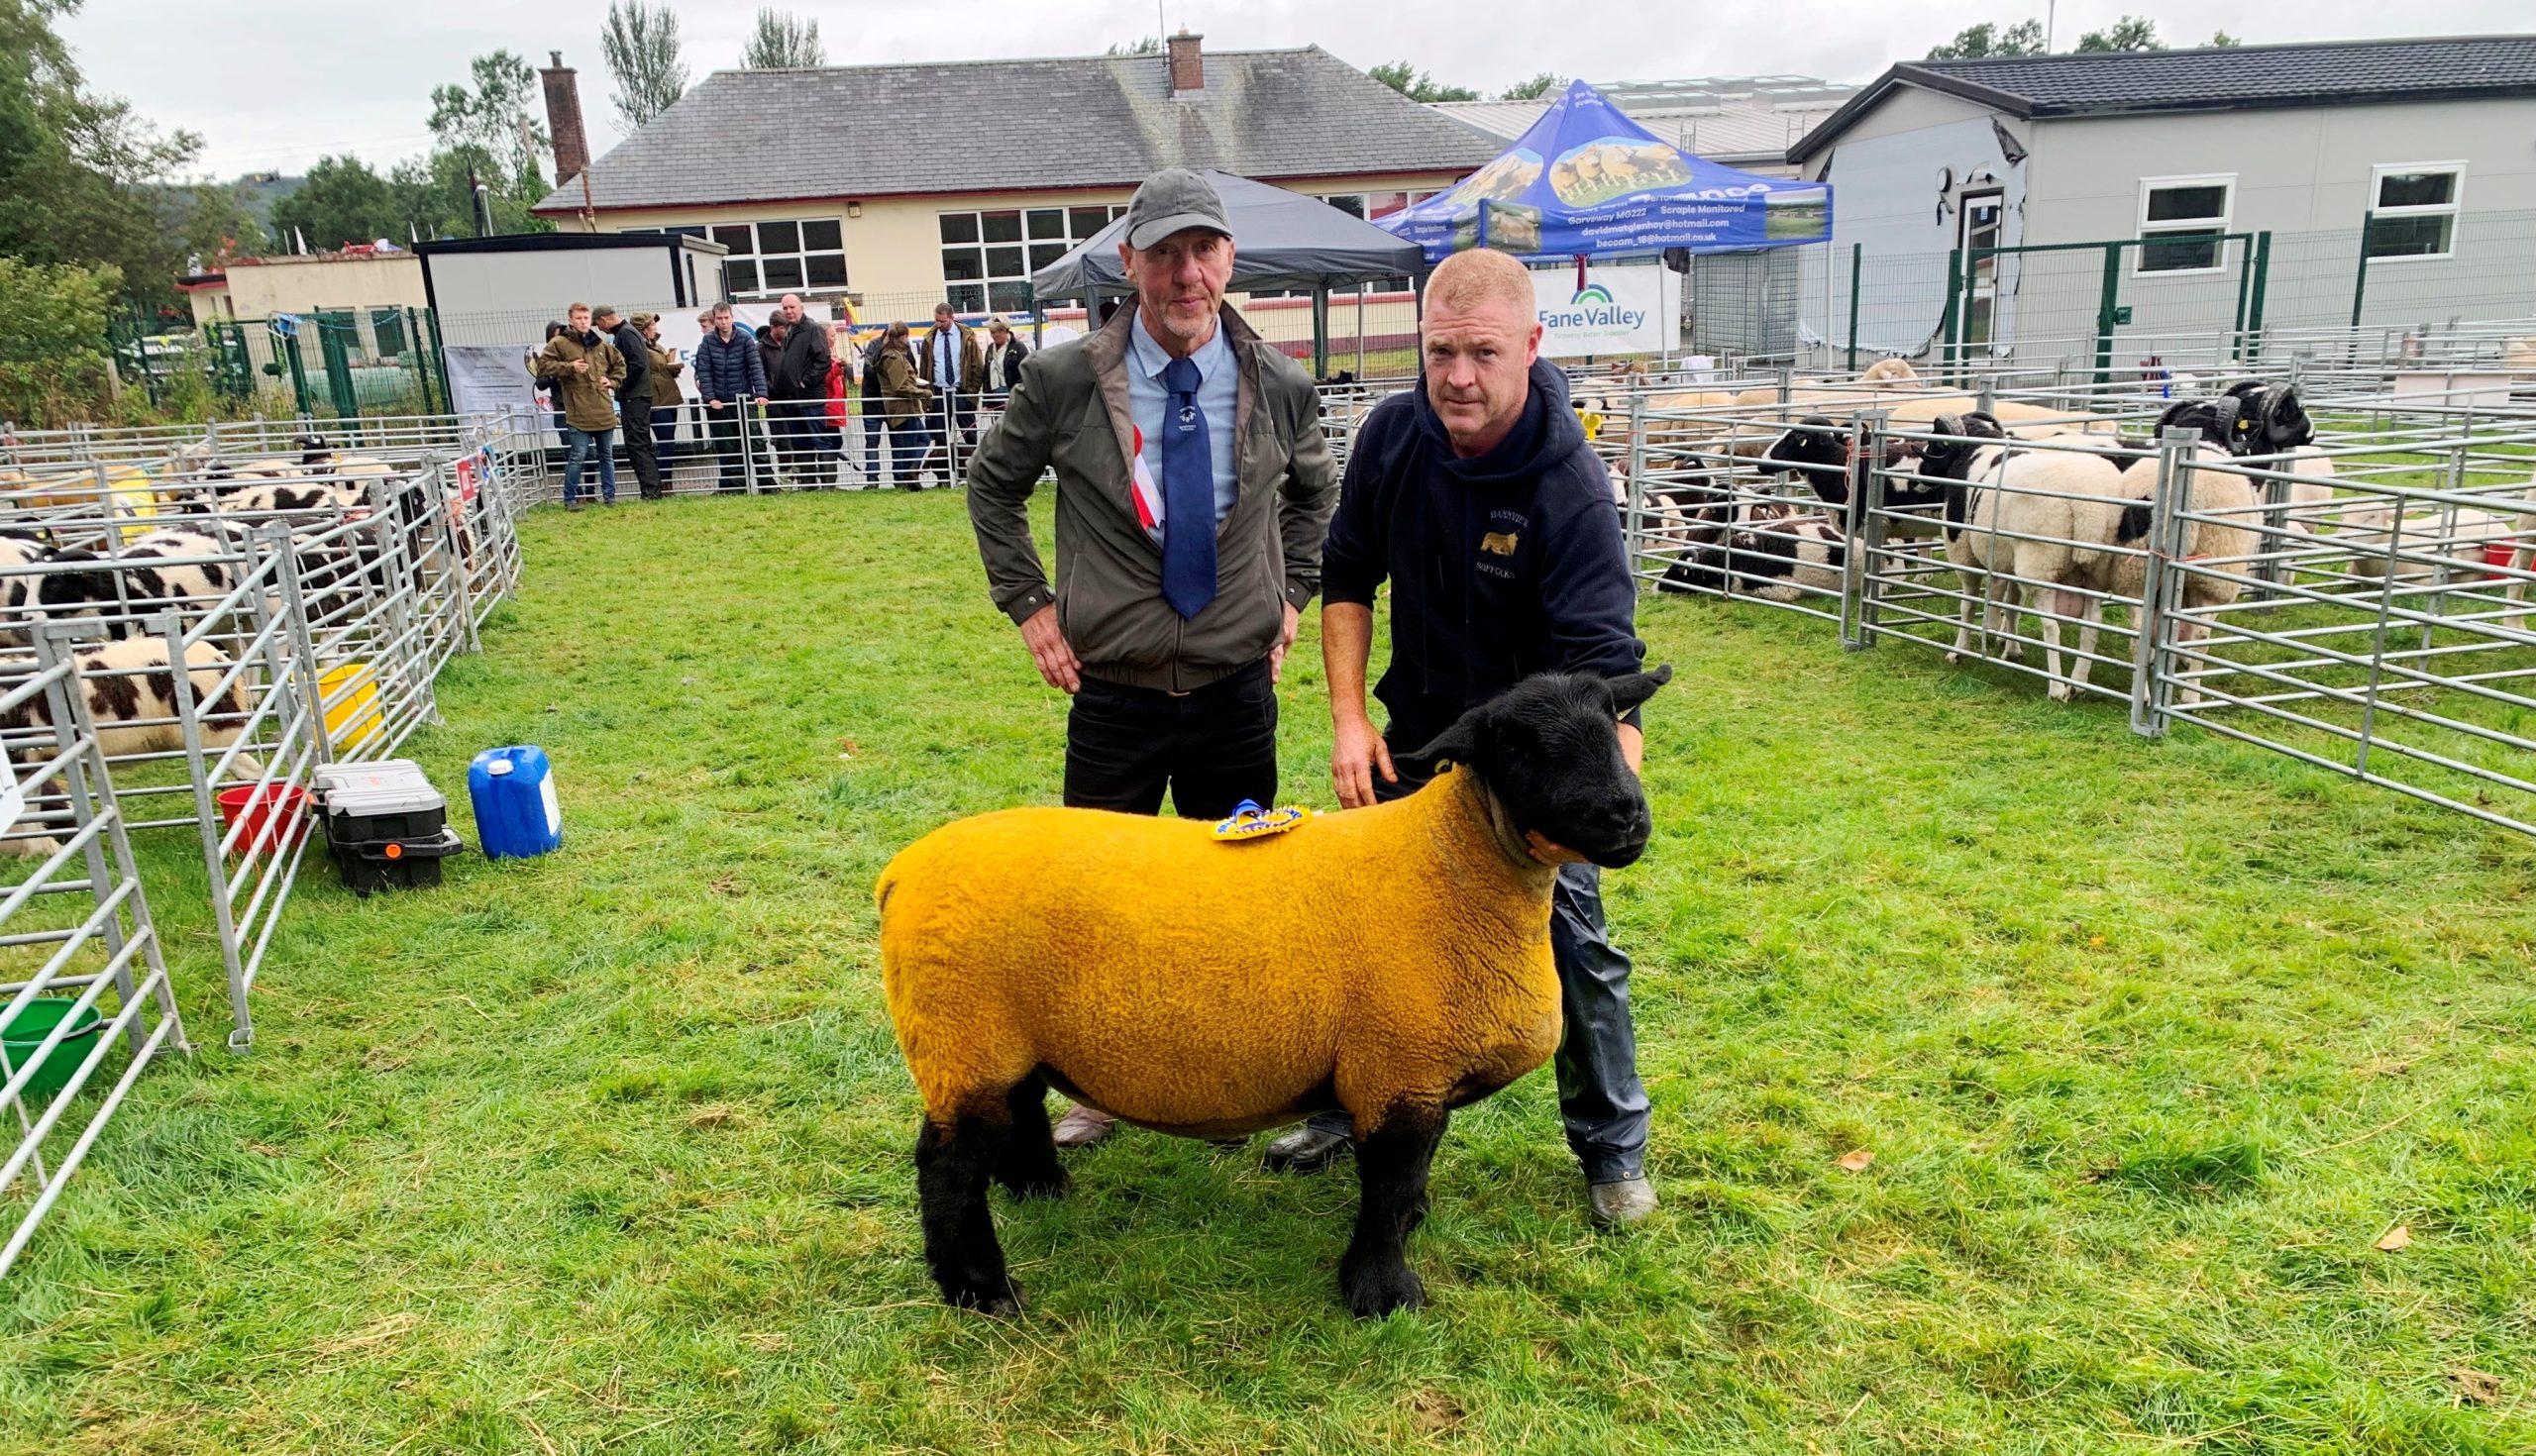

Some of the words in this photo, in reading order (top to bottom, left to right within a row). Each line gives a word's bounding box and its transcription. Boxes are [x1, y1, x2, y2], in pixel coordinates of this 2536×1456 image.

[1616, 208, 1646, 219] MG222
[1660, 204, 1696, 216] Scrapie
[1697, 203, 1746, 214] Monitored
[1538, 310, 1584, 328] Fane
[1585, 305, 1645, 330] Valley
